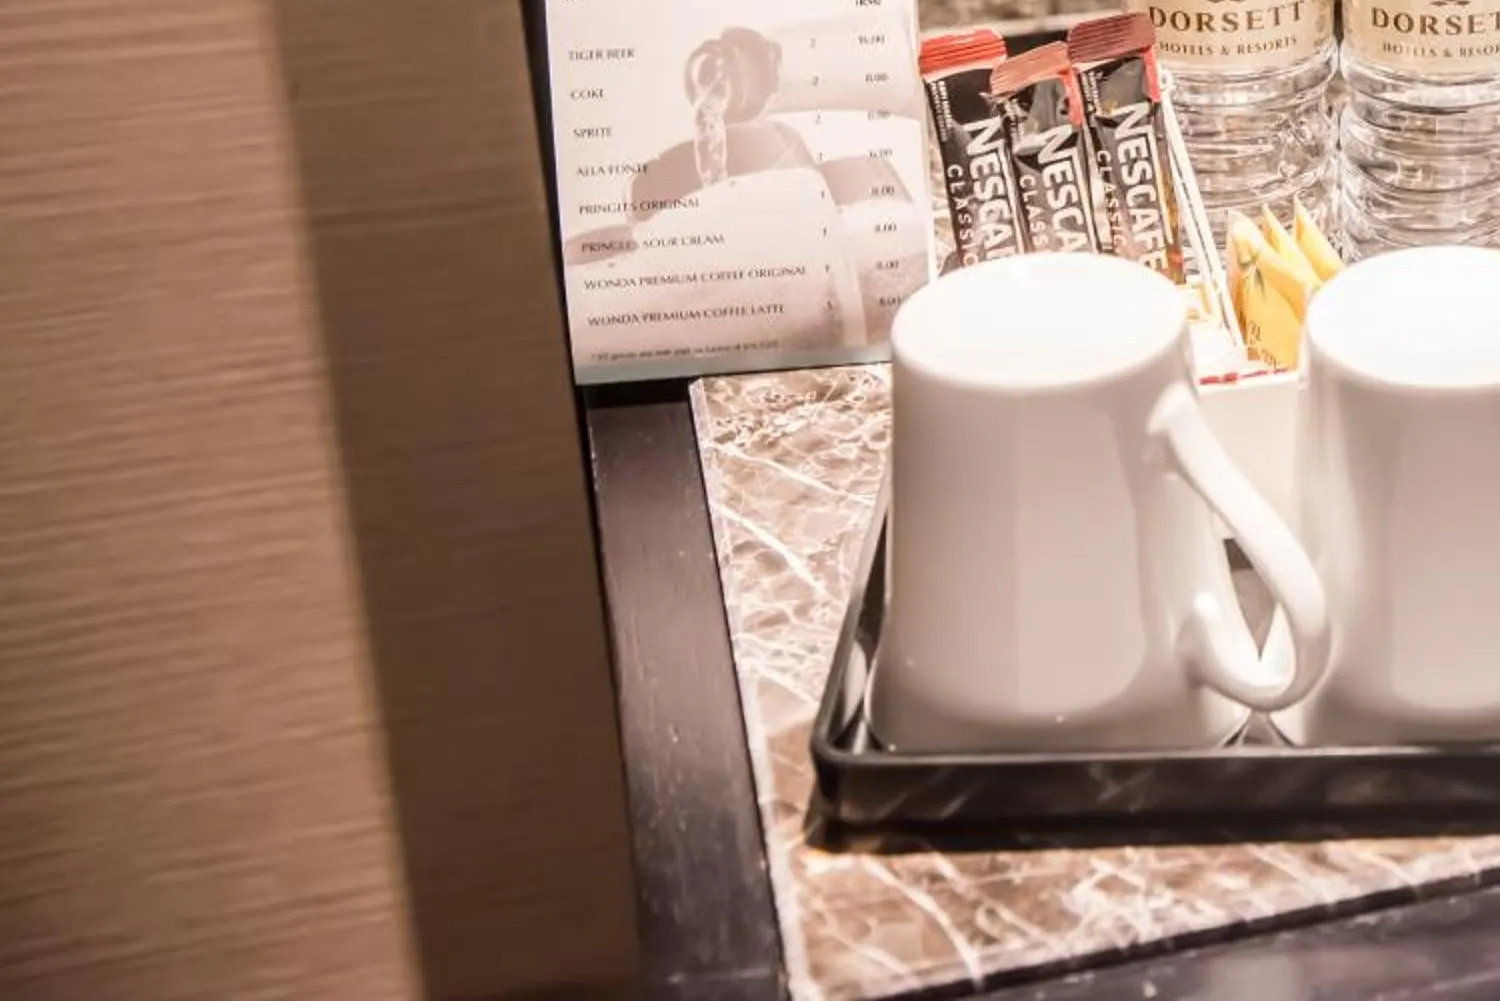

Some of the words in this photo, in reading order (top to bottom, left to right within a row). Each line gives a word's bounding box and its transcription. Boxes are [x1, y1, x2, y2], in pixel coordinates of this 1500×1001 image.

[1159, 40, 1213, 56] HOTELS
[1220, 46, 1231, 56] &
[1237, 35, 1297, 55] RESORTS
[1382, 42, 1438, 58] HOTELS
[1443, 48, 1454, 58] &
[570, 88, 604, 100] COKE
[573, 127, 612, 139] SPRITE
[579, 202, 637, 216] PRINGLES
[640, 198, 699, 212] ORIGINAL
[947, 163, 980, 267] CLASSIC
[1019, 174, 1049, 249] CLASS
[581, 239, 639, 253] PRINGLES
[643, 236, 678, 248] SOUR
[681, 234, 725, 247] CREAM
[584, 277, 637, 290] WONDA
[639, 274, 698, 287] PREMIUM
[747, 265, 806, 279] ORIGINAL
[587, 314, 640, 327] WONDA
[642, 310, 701, 323] PREMIUM
[703, 306, 747, 319] COFFEE
[749, 303, 785, 316] LATTE
